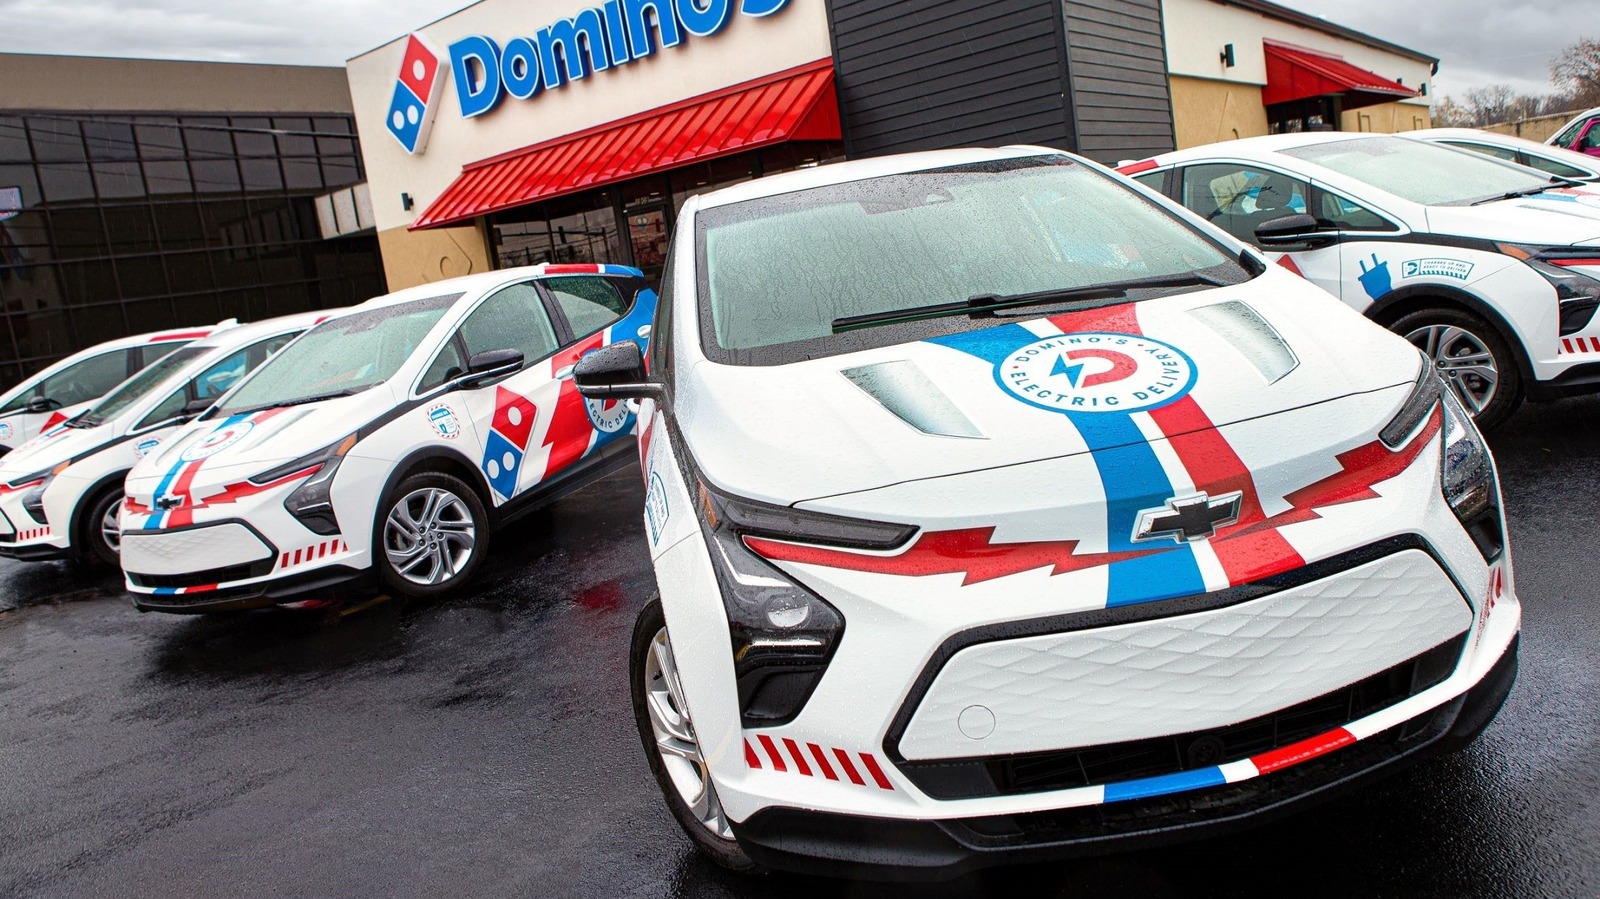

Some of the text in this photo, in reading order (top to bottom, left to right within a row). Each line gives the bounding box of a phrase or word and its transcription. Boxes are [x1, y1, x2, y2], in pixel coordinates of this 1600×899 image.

[448, 0, 789, 119] Domino
[1015, 337, 1128, 362] DOMINO'S
[1011, 348, 1180, 406] ELECTRIC DELIVERY
[588, 399, 628, 428] ECTRIC DELI
